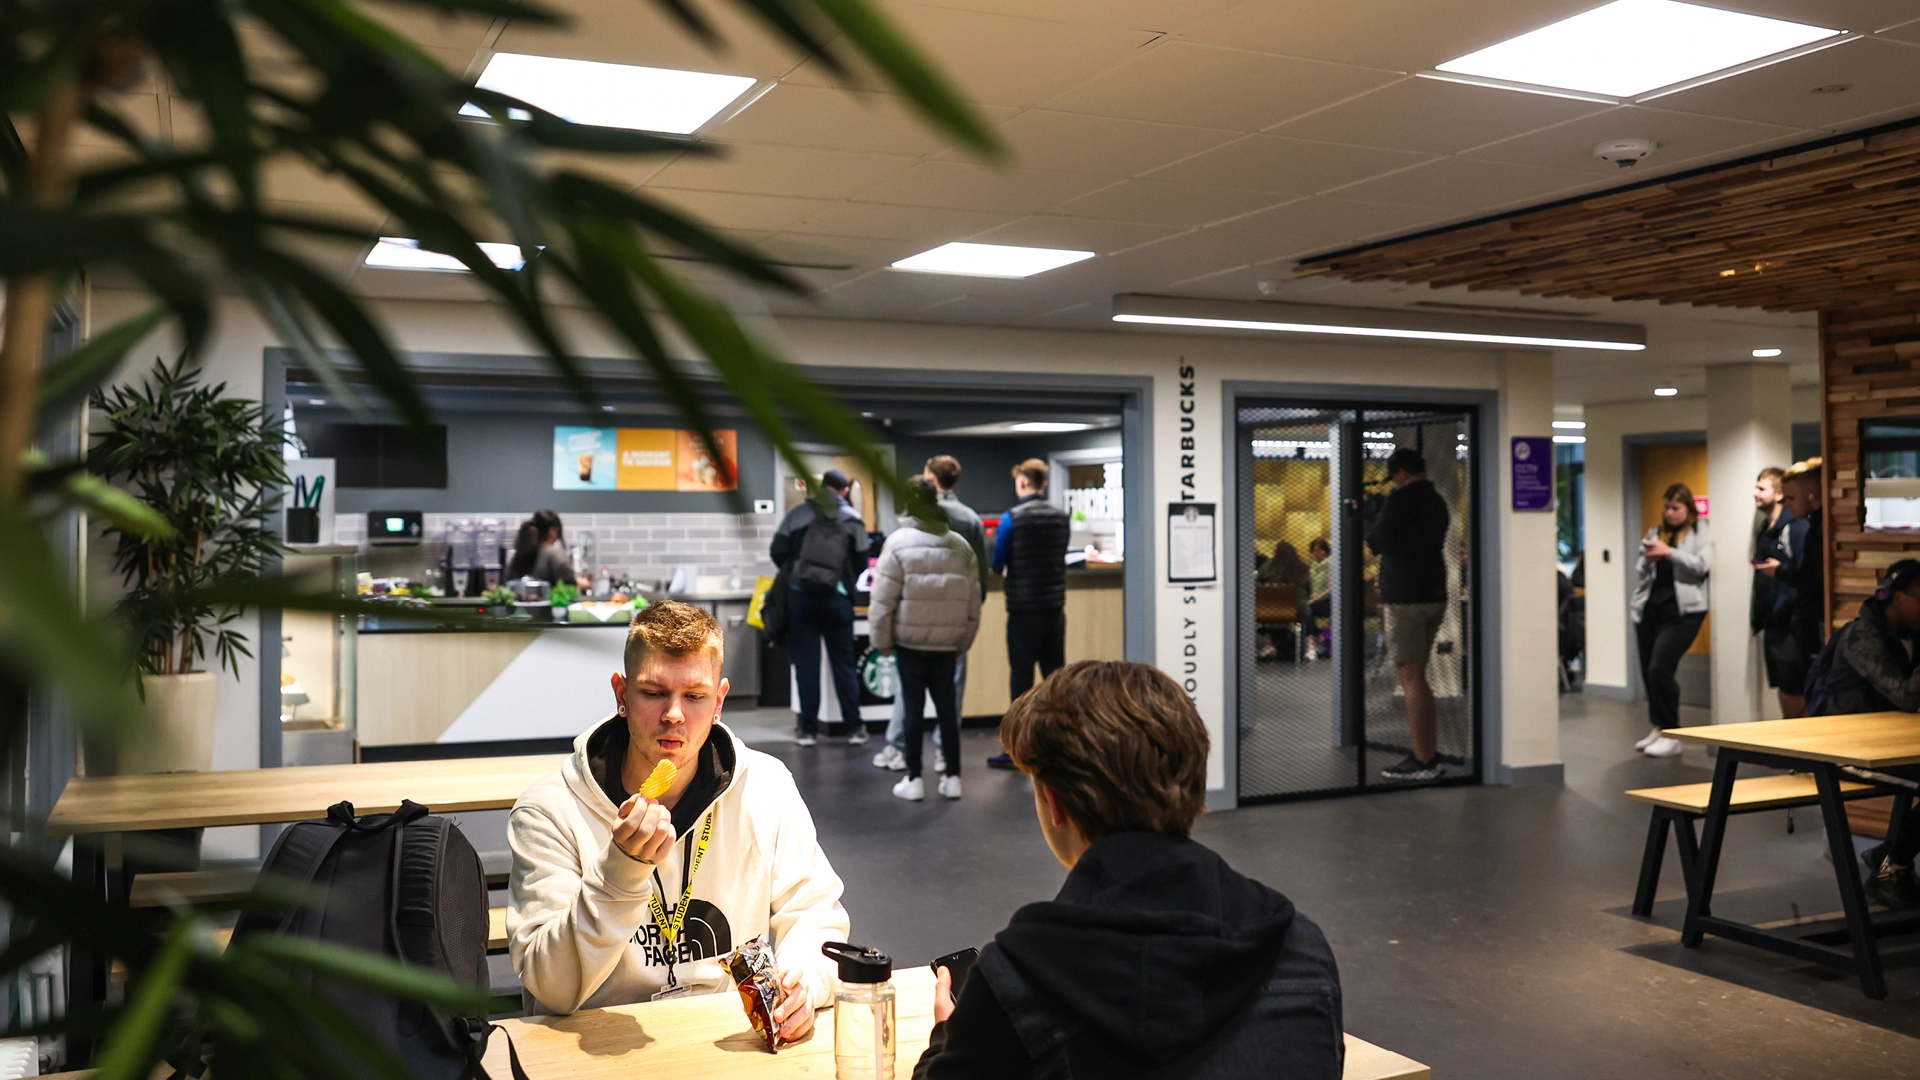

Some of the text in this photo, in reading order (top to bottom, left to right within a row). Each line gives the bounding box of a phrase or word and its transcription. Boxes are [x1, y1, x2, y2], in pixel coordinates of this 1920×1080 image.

[1179, 364, 1195, 502] TARBUCKS
[650, 894, 669, 930] TUDENT
[673, 890, 691, 930] STUDENT
